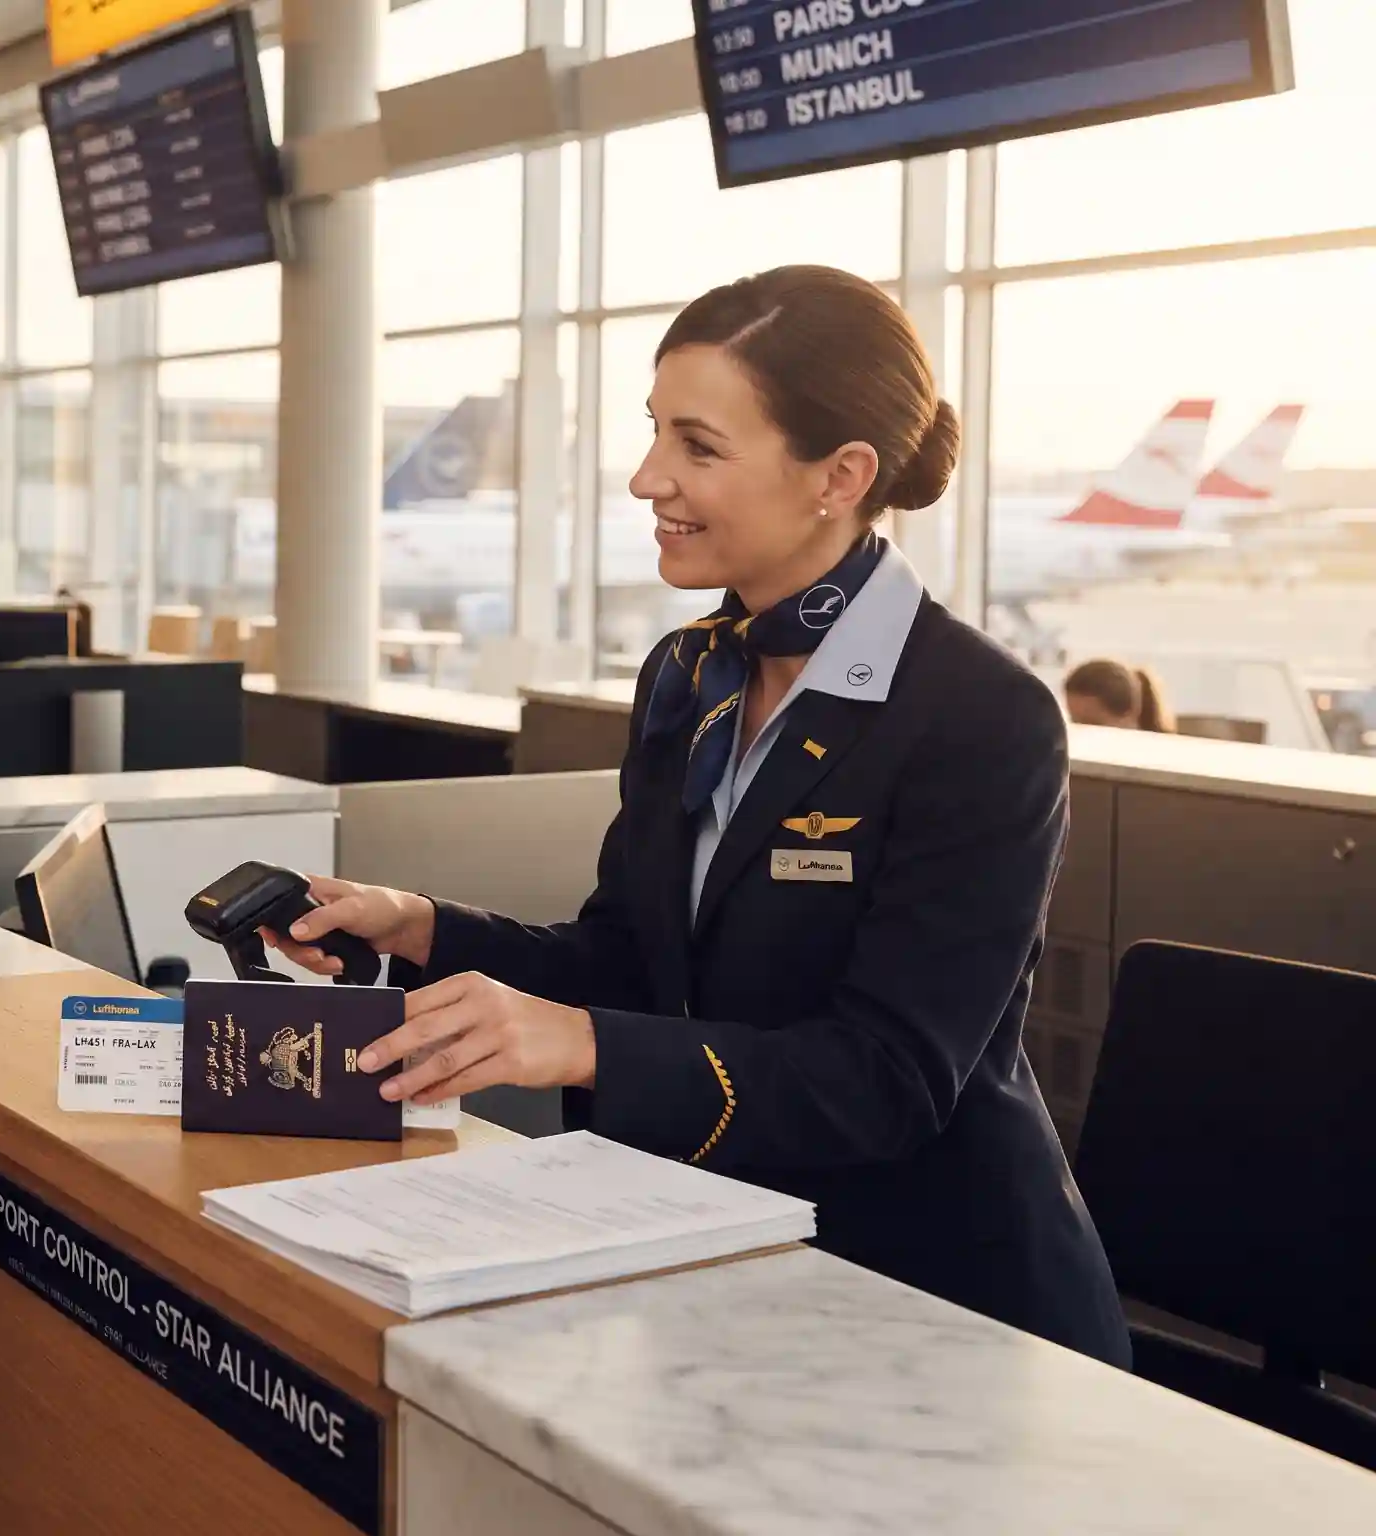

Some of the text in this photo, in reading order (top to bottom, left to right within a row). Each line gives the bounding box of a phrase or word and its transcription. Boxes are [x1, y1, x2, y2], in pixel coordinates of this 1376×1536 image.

[774, 0, 854, 41] PARIS
[780, 29, 893, 84] MUNICH
[785, 69, 924, 126] ISTANBUL
[112, 1038, 157, 1050] FRA-LAX
[43, 1226, 136, 1315] CONTROL
[155, 1299, 211, 1368] STAR
[217, 1341, 345, 1458] ALLIANCE
